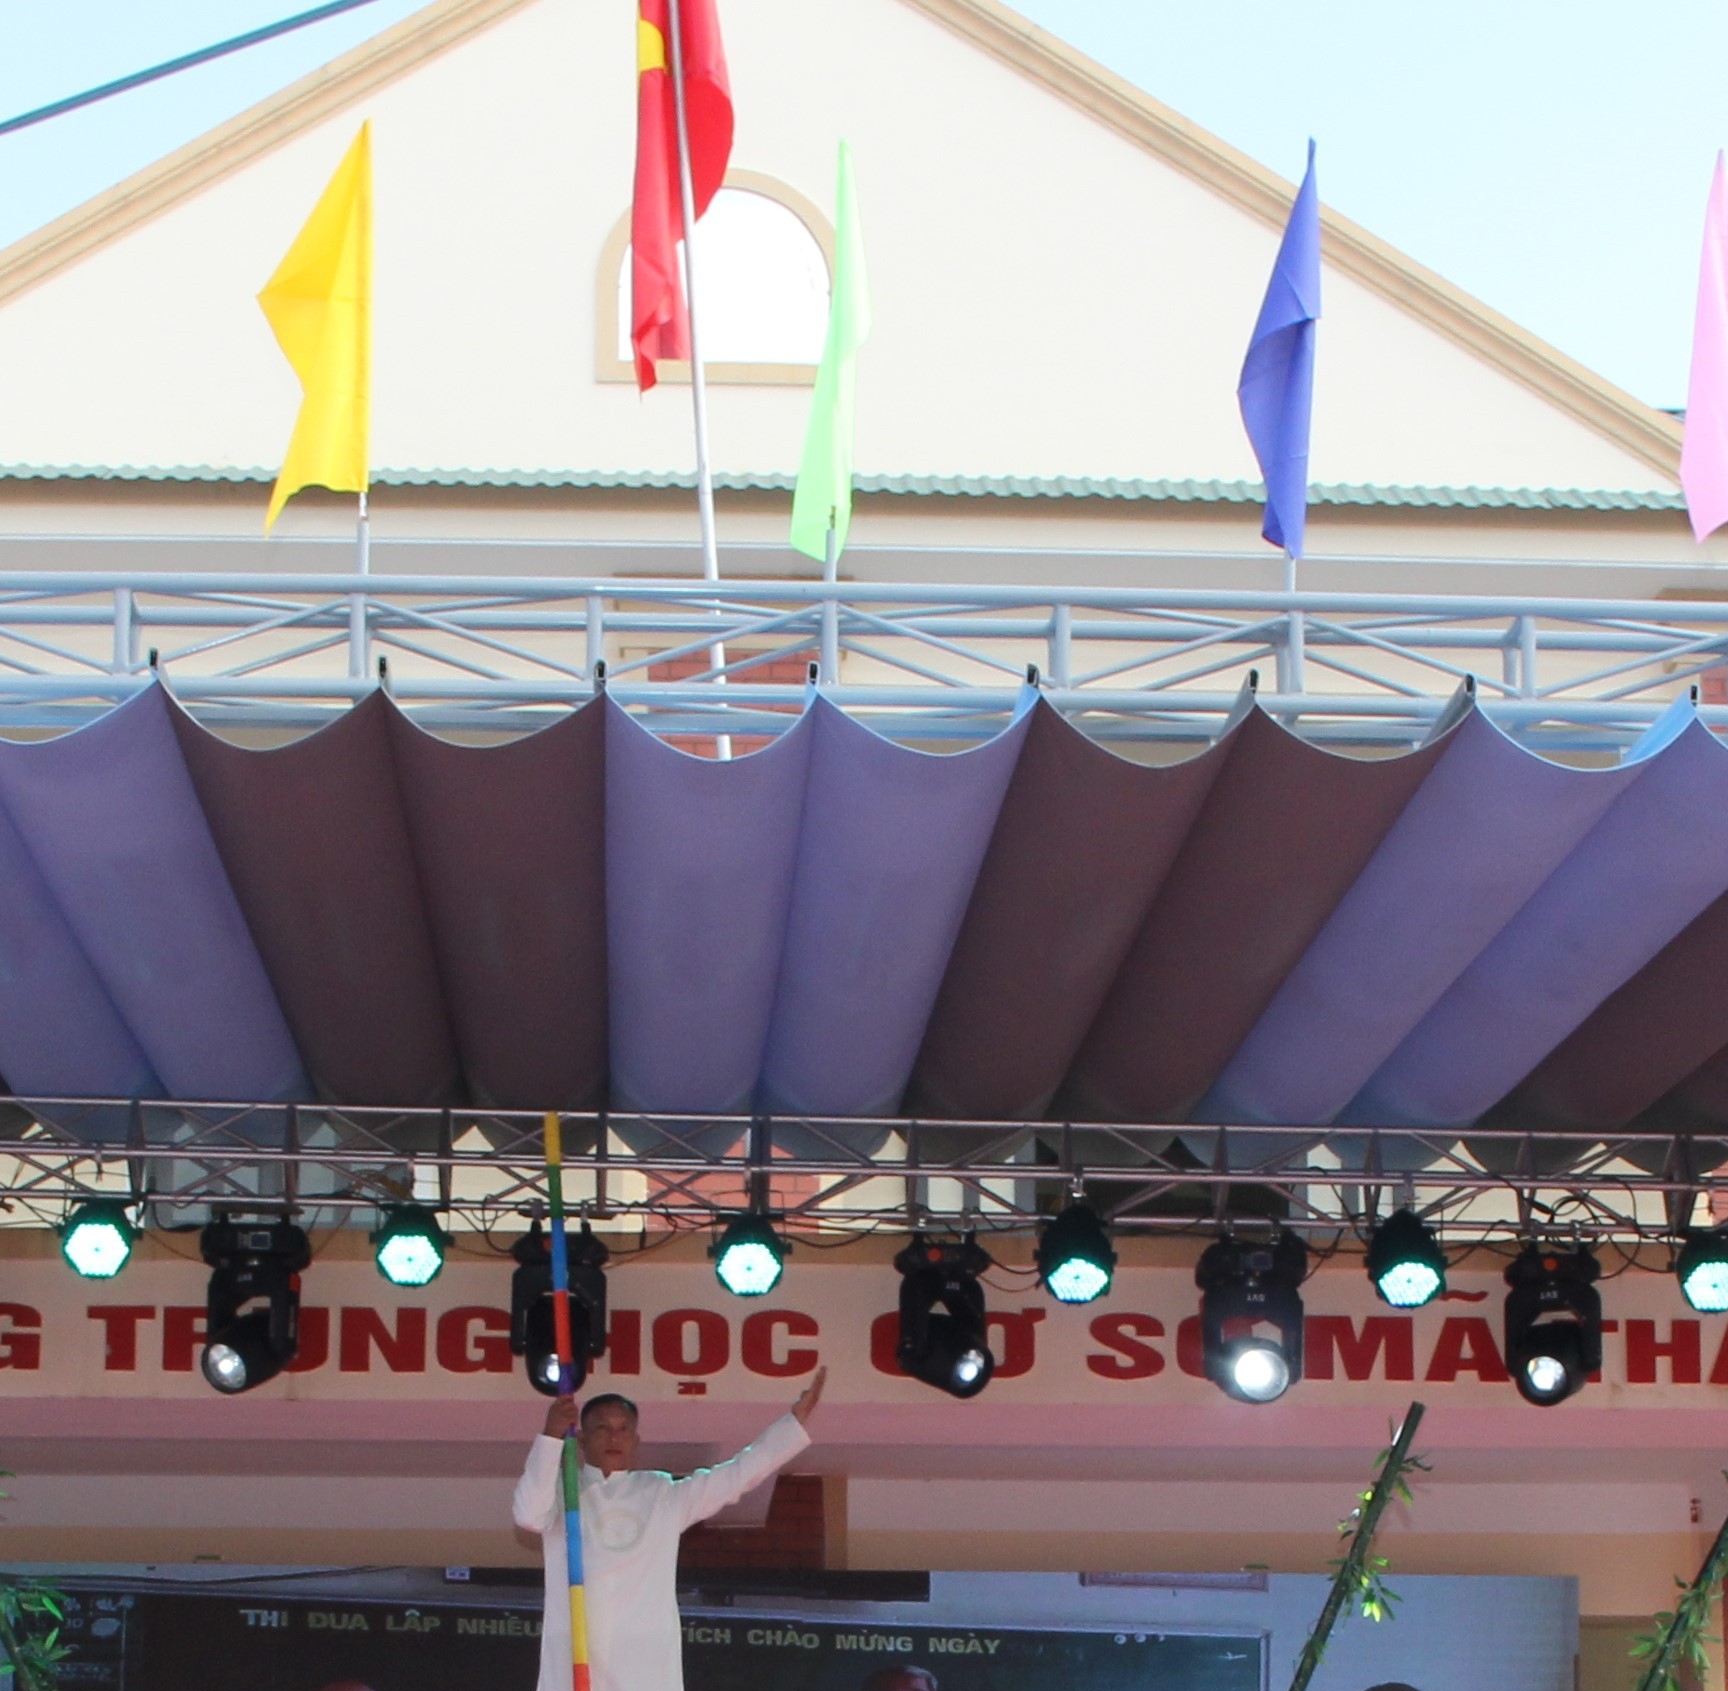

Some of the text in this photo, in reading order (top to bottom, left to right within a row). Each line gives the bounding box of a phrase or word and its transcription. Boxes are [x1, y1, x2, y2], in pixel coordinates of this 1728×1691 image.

[1304, 1289, 1510, 1382] MÃ
[238, 1608, 289, 1628] THI
[680, 1621, 732, 1644] ÍCH
[747, 1624, 821, 1649] CHÀO
[928, 1632, 1001, 1655] NGÀY
